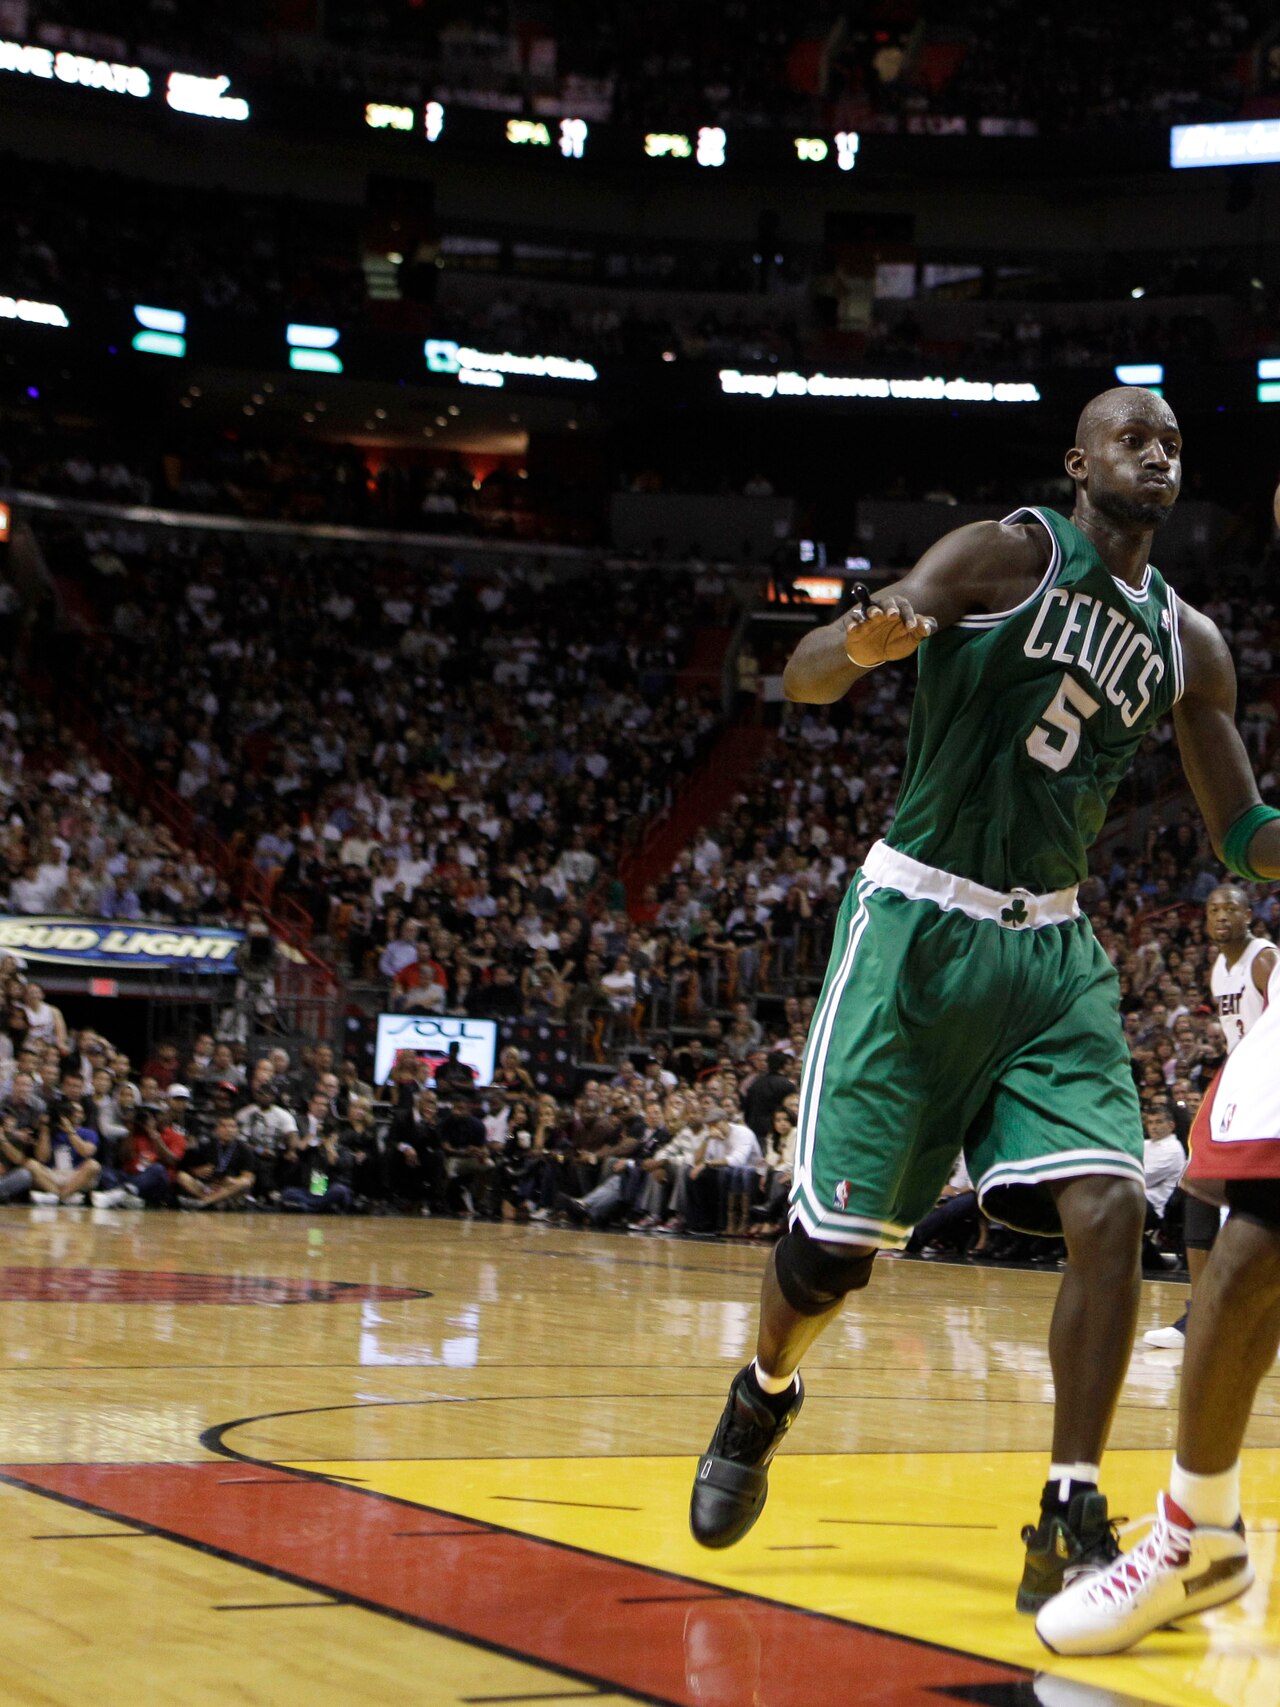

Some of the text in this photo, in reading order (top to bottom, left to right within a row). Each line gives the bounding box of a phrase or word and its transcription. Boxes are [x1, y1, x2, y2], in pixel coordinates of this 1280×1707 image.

[1023, 588, 1165, 728] CELTICS
[1026, 673, 1100, 772] 5
[1, 924, 240, 960] BUD LIGHT
[387, 1020, 484, 1040] SOUL
